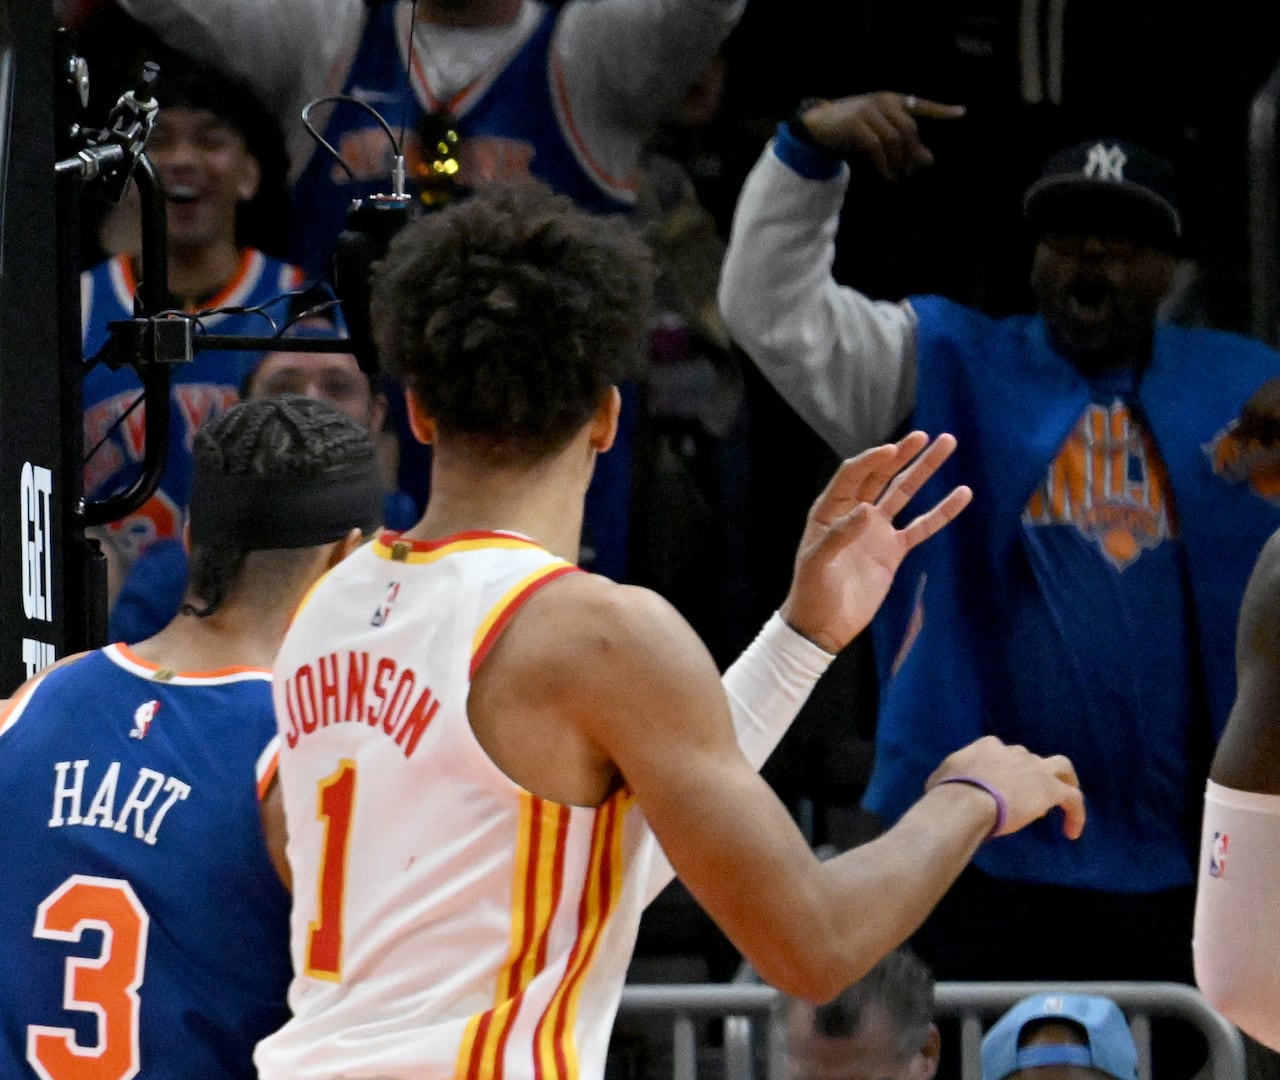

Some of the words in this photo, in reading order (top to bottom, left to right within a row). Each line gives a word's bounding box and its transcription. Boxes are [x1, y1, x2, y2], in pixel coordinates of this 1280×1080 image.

[20, 461, 53, 623] GET
[285, 650, 442, 761] JOHNSON
[47, 759, 192, 846] HART
[303, 757, 358, 985] 1
